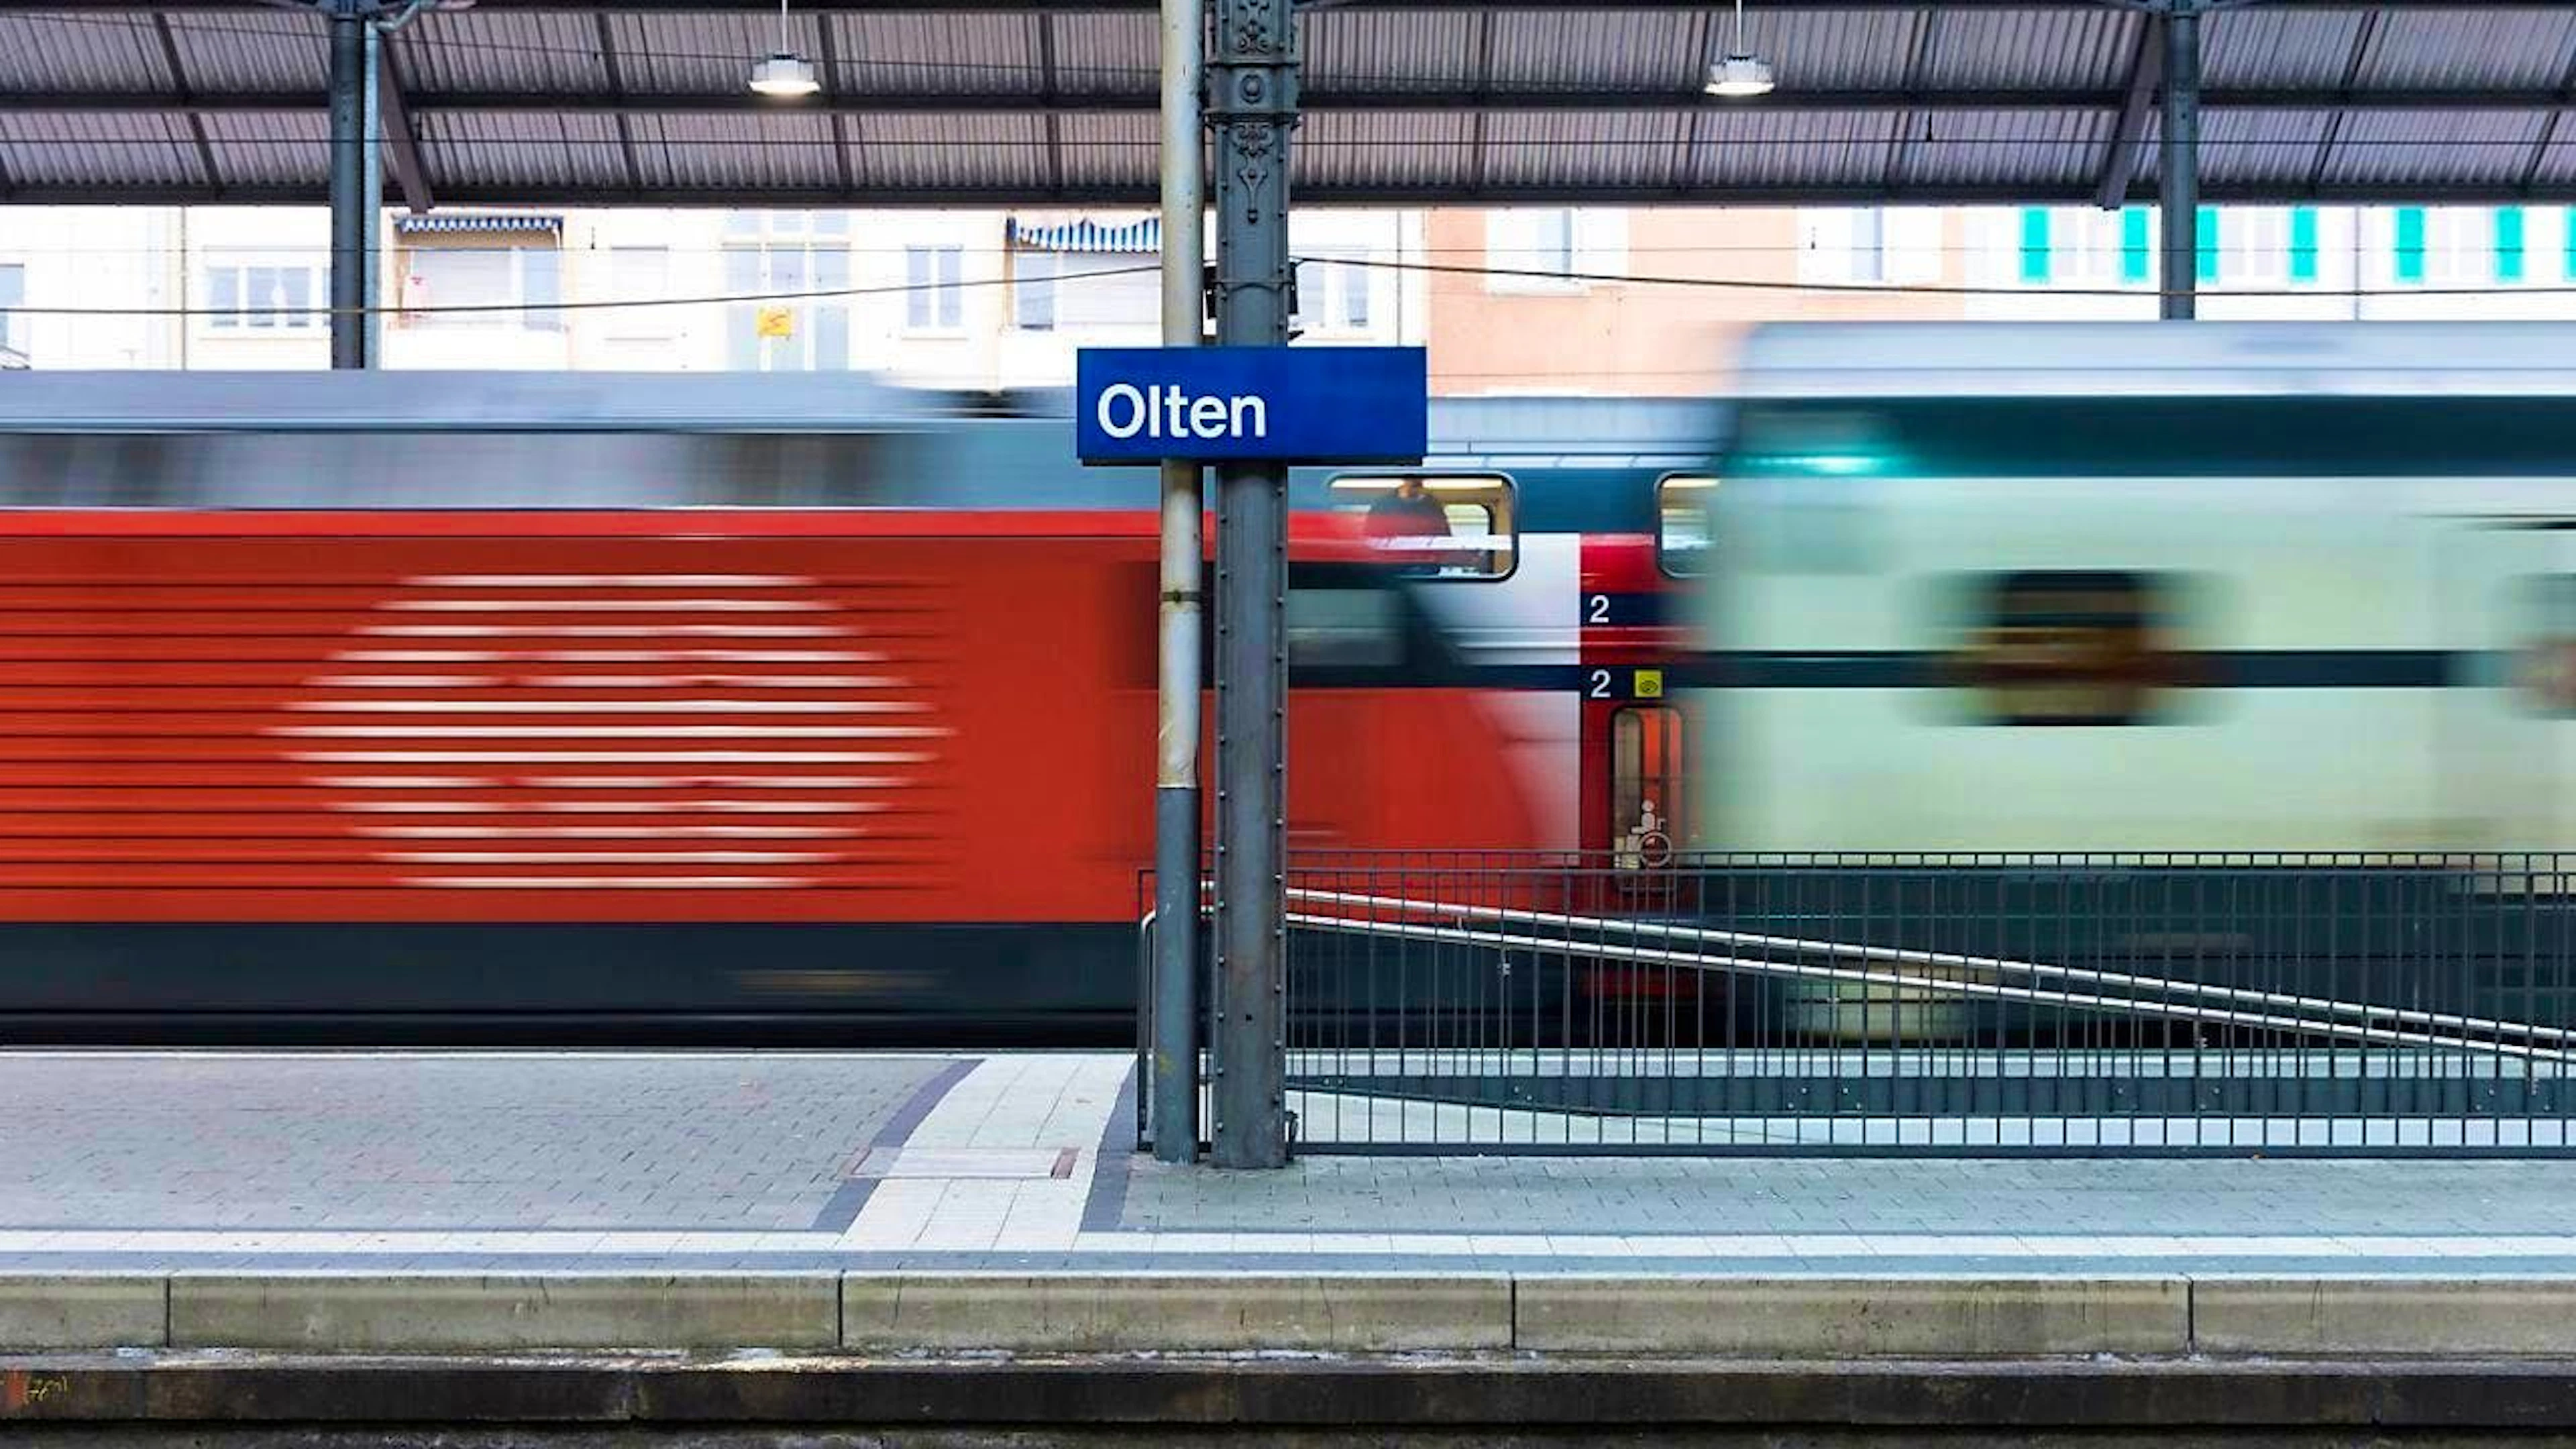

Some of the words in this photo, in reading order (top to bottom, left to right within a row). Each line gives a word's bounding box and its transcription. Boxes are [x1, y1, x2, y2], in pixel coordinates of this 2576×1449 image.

[1097, 383, 1267, 438] Olten
[1589, 594, 1609, 623] 2
[1591, 669, 1611, 698] 2
